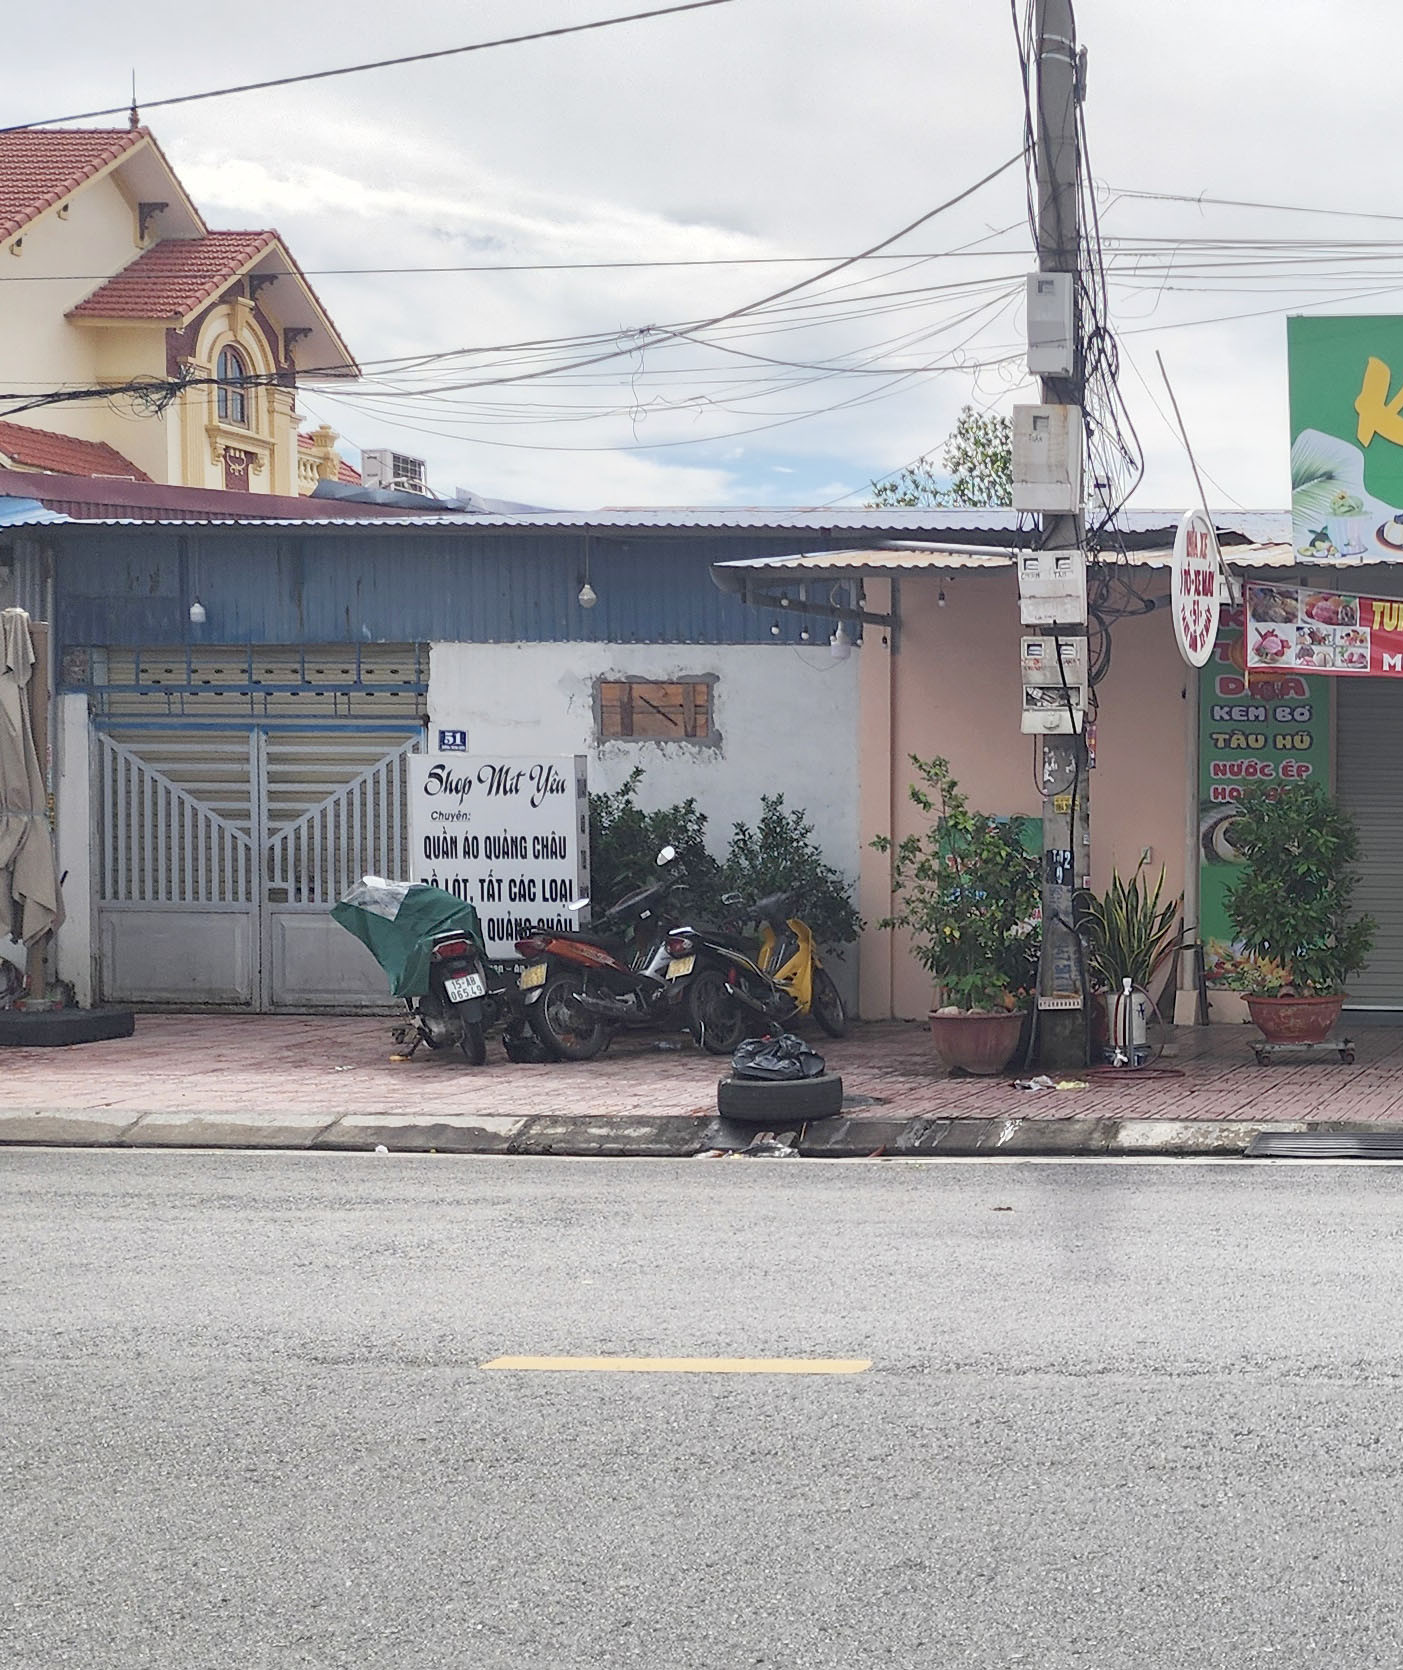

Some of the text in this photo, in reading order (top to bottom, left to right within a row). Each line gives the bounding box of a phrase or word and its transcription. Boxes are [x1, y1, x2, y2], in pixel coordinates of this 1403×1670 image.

[1213, 705, 1312, 722] KEM BƠ
[444, 732, 462, 745] 51
[1212, 732, 1265, 749] TÀU
[1211, 759, 1312, 779] NƯỚC ÉP
[424, 764, 472, 806] Shop
[430, 810, 471, 822] Chuyên:
[423, 827, 567, 860] QUẦN ÁO QUẢNG CHÂU
[479, 869, 503, 903] TẤT
[508, 874, 536, 903] CÁC
[542, 879, 573, 908] LOẠI
